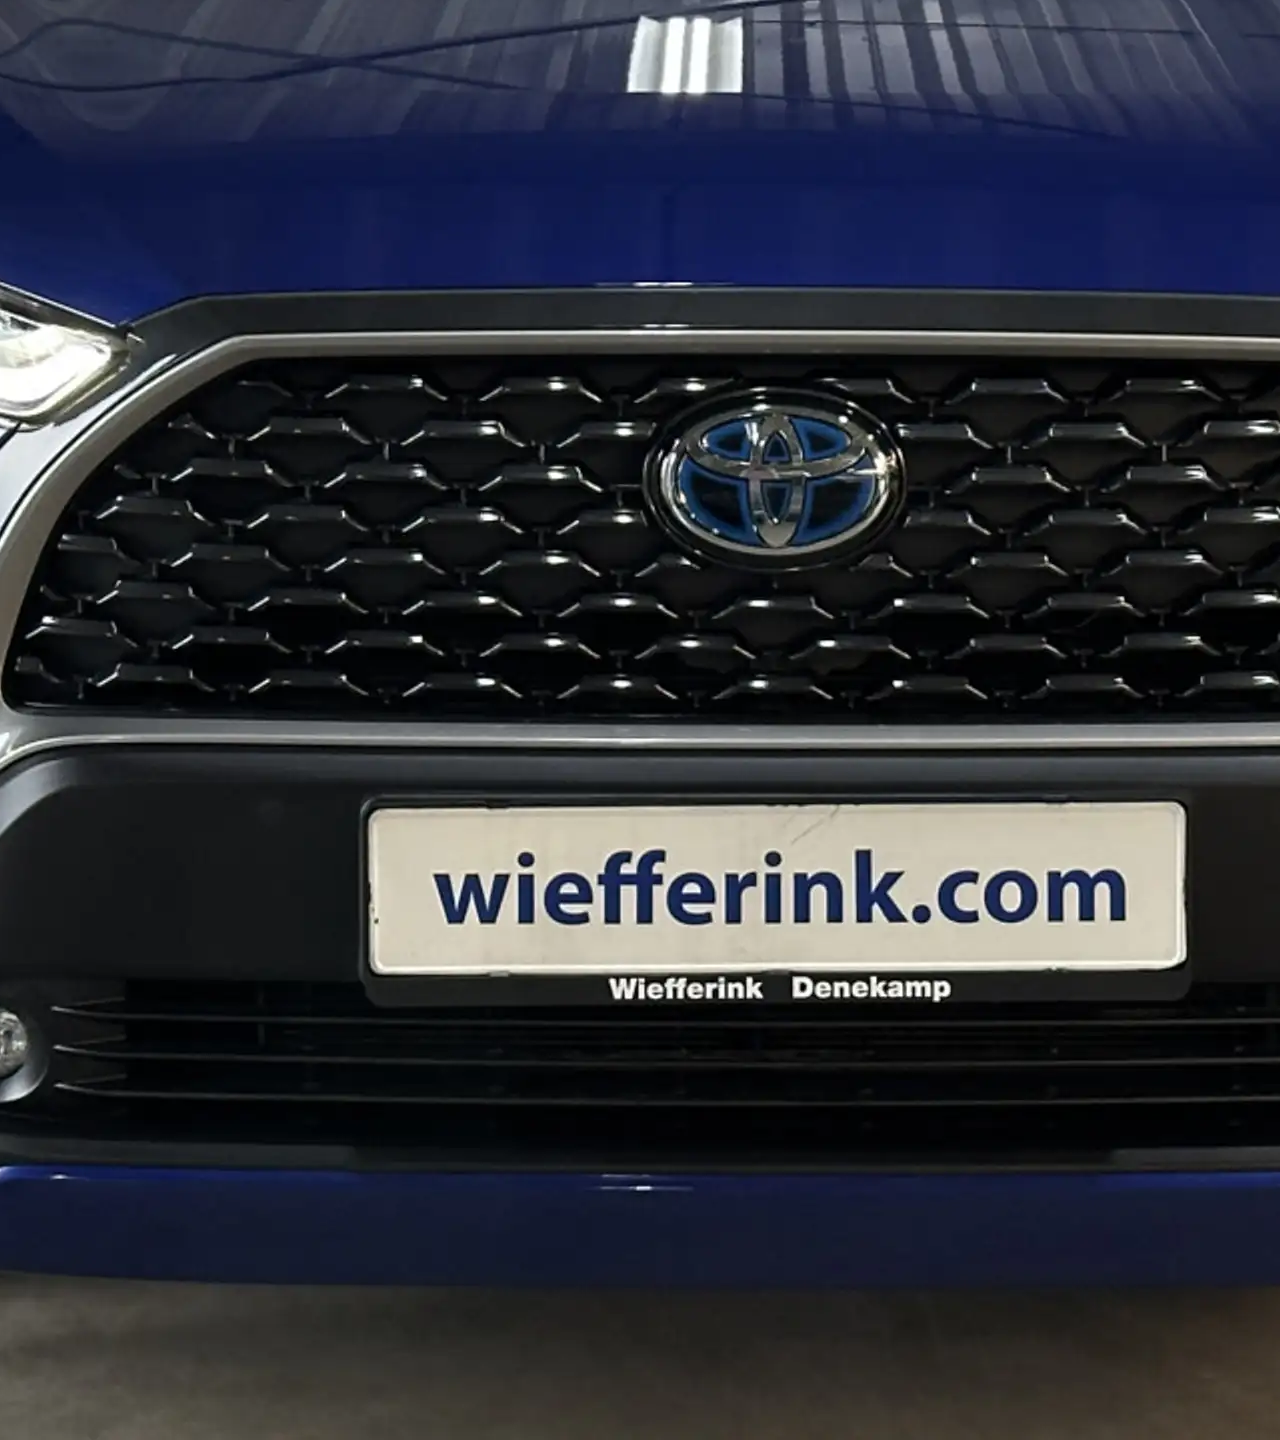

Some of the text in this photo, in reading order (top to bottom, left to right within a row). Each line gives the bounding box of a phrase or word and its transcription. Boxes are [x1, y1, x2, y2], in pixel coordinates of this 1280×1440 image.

[434, 850, 1126, 925] wiefferink.com
[608, 975, 952, 1003] Wiefferink Denekamp
